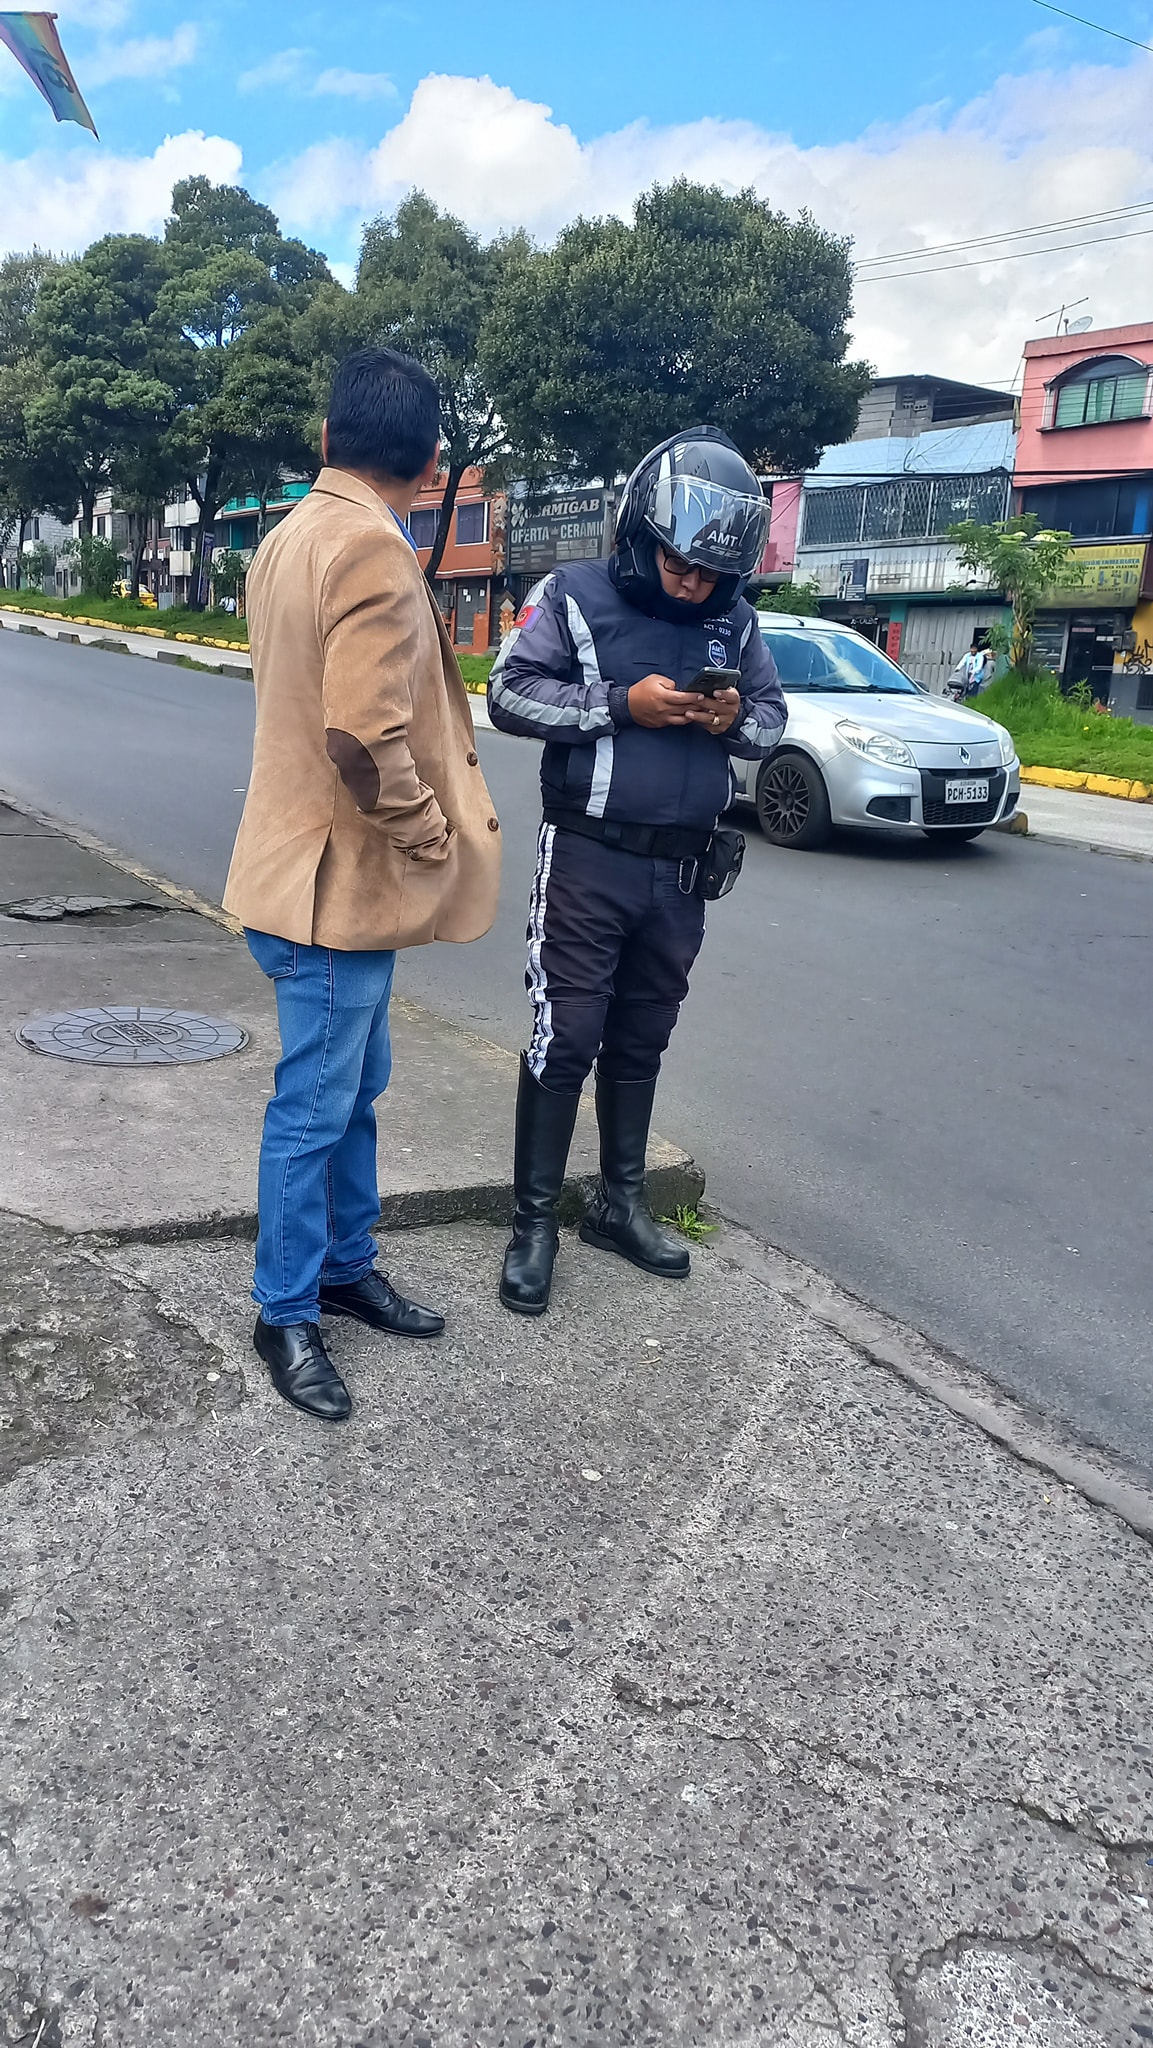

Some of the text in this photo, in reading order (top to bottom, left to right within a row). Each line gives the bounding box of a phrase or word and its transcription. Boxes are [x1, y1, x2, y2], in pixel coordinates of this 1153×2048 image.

[511, 526, 550, 544] OFERTA
[707, 530, 738, 547] AMT
[692, 539, 742, 559] LS2
[947, 787, 988, 800] PCH-5133
